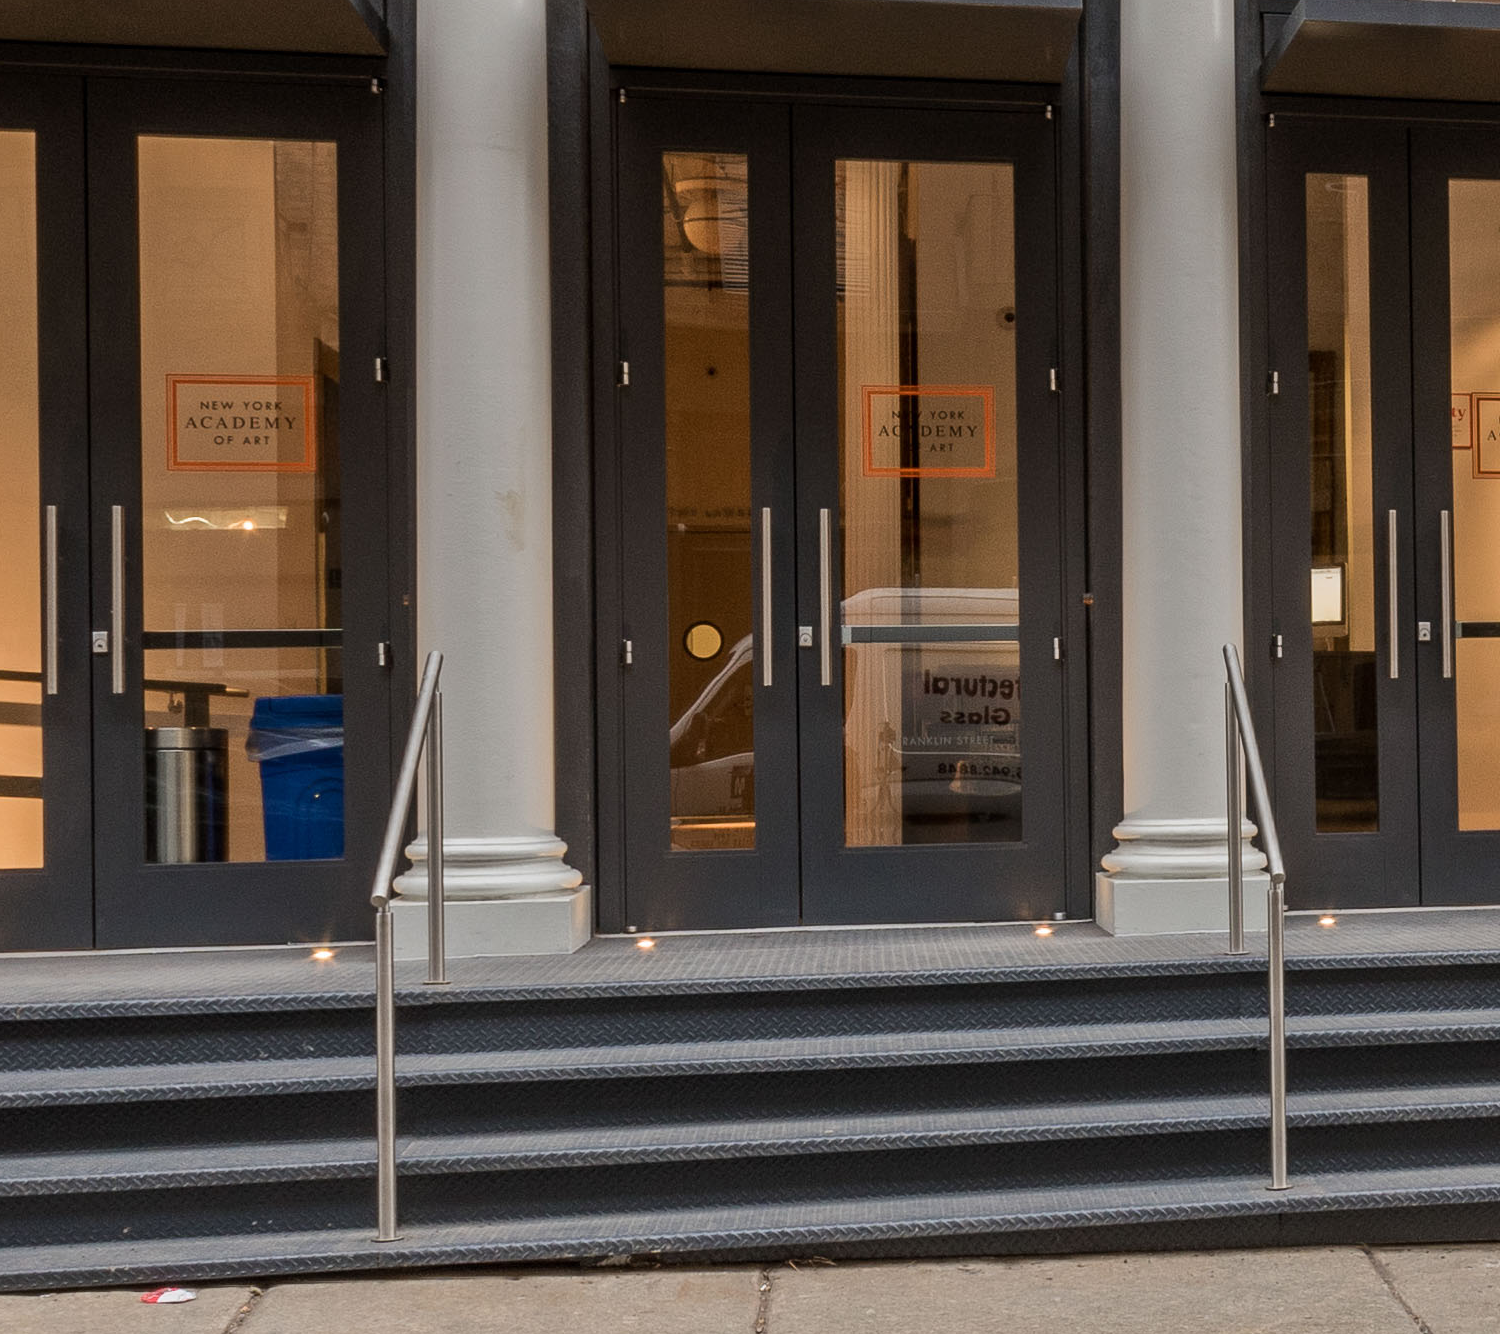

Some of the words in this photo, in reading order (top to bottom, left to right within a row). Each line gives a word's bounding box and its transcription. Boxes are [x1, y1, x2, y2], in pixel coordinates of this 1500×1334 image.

[200, 401, 234, 411] NEW
[244, 401, 283, 411] YORK
[931, 410, 965, 420] YORK
[185, 416, 296, 429] ACADEMY
[878, 426, 978, 437] ACDEMY
[214, 436, 234, 446] OF
[243, 436, 270, 446] ART
[930, 443, 954, 452] ART
[901, 736, 952, 747] RANKLIN
[956, 736, 995, 746] STREET
